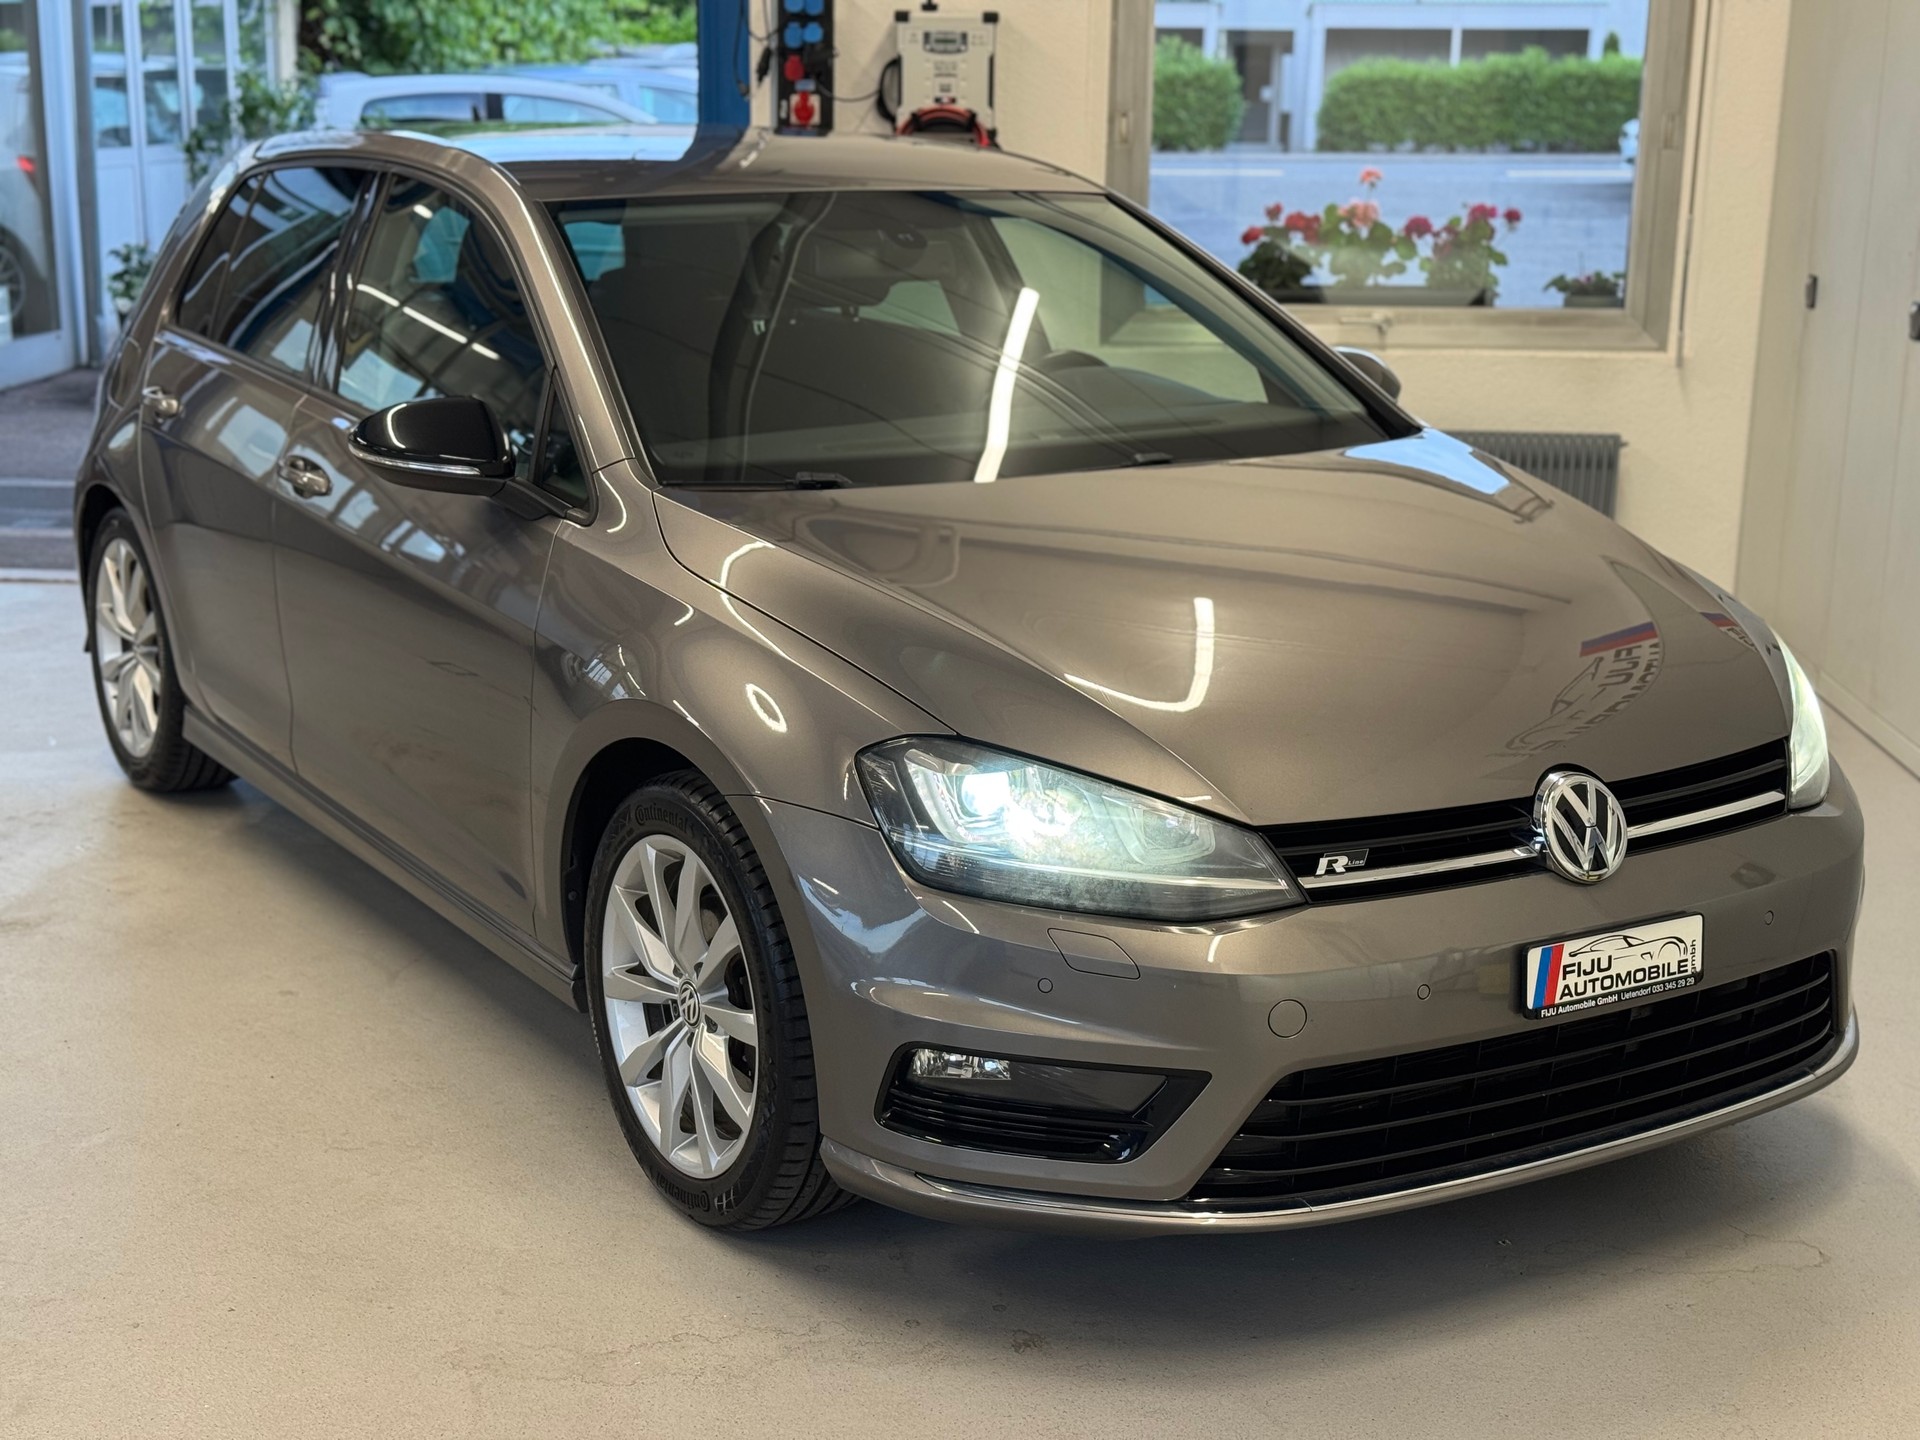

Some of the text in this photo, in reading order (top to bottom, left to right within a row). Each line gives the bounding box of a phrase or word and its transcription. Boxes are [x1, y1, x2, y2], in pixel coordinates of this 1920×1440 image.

[635, 803, 688, 834] Continental
[1315, 855, 1349, 875] R
[1559, 958, 1689, 1000] AUTOMOBILE
[1562, 955, 1612, 980] FIJU
[1541, 977, 1695, 1018] FIJU Automobile GmbH Uetendorf 033 345 29 29
[656, 1172, 711, 1212] Continental
